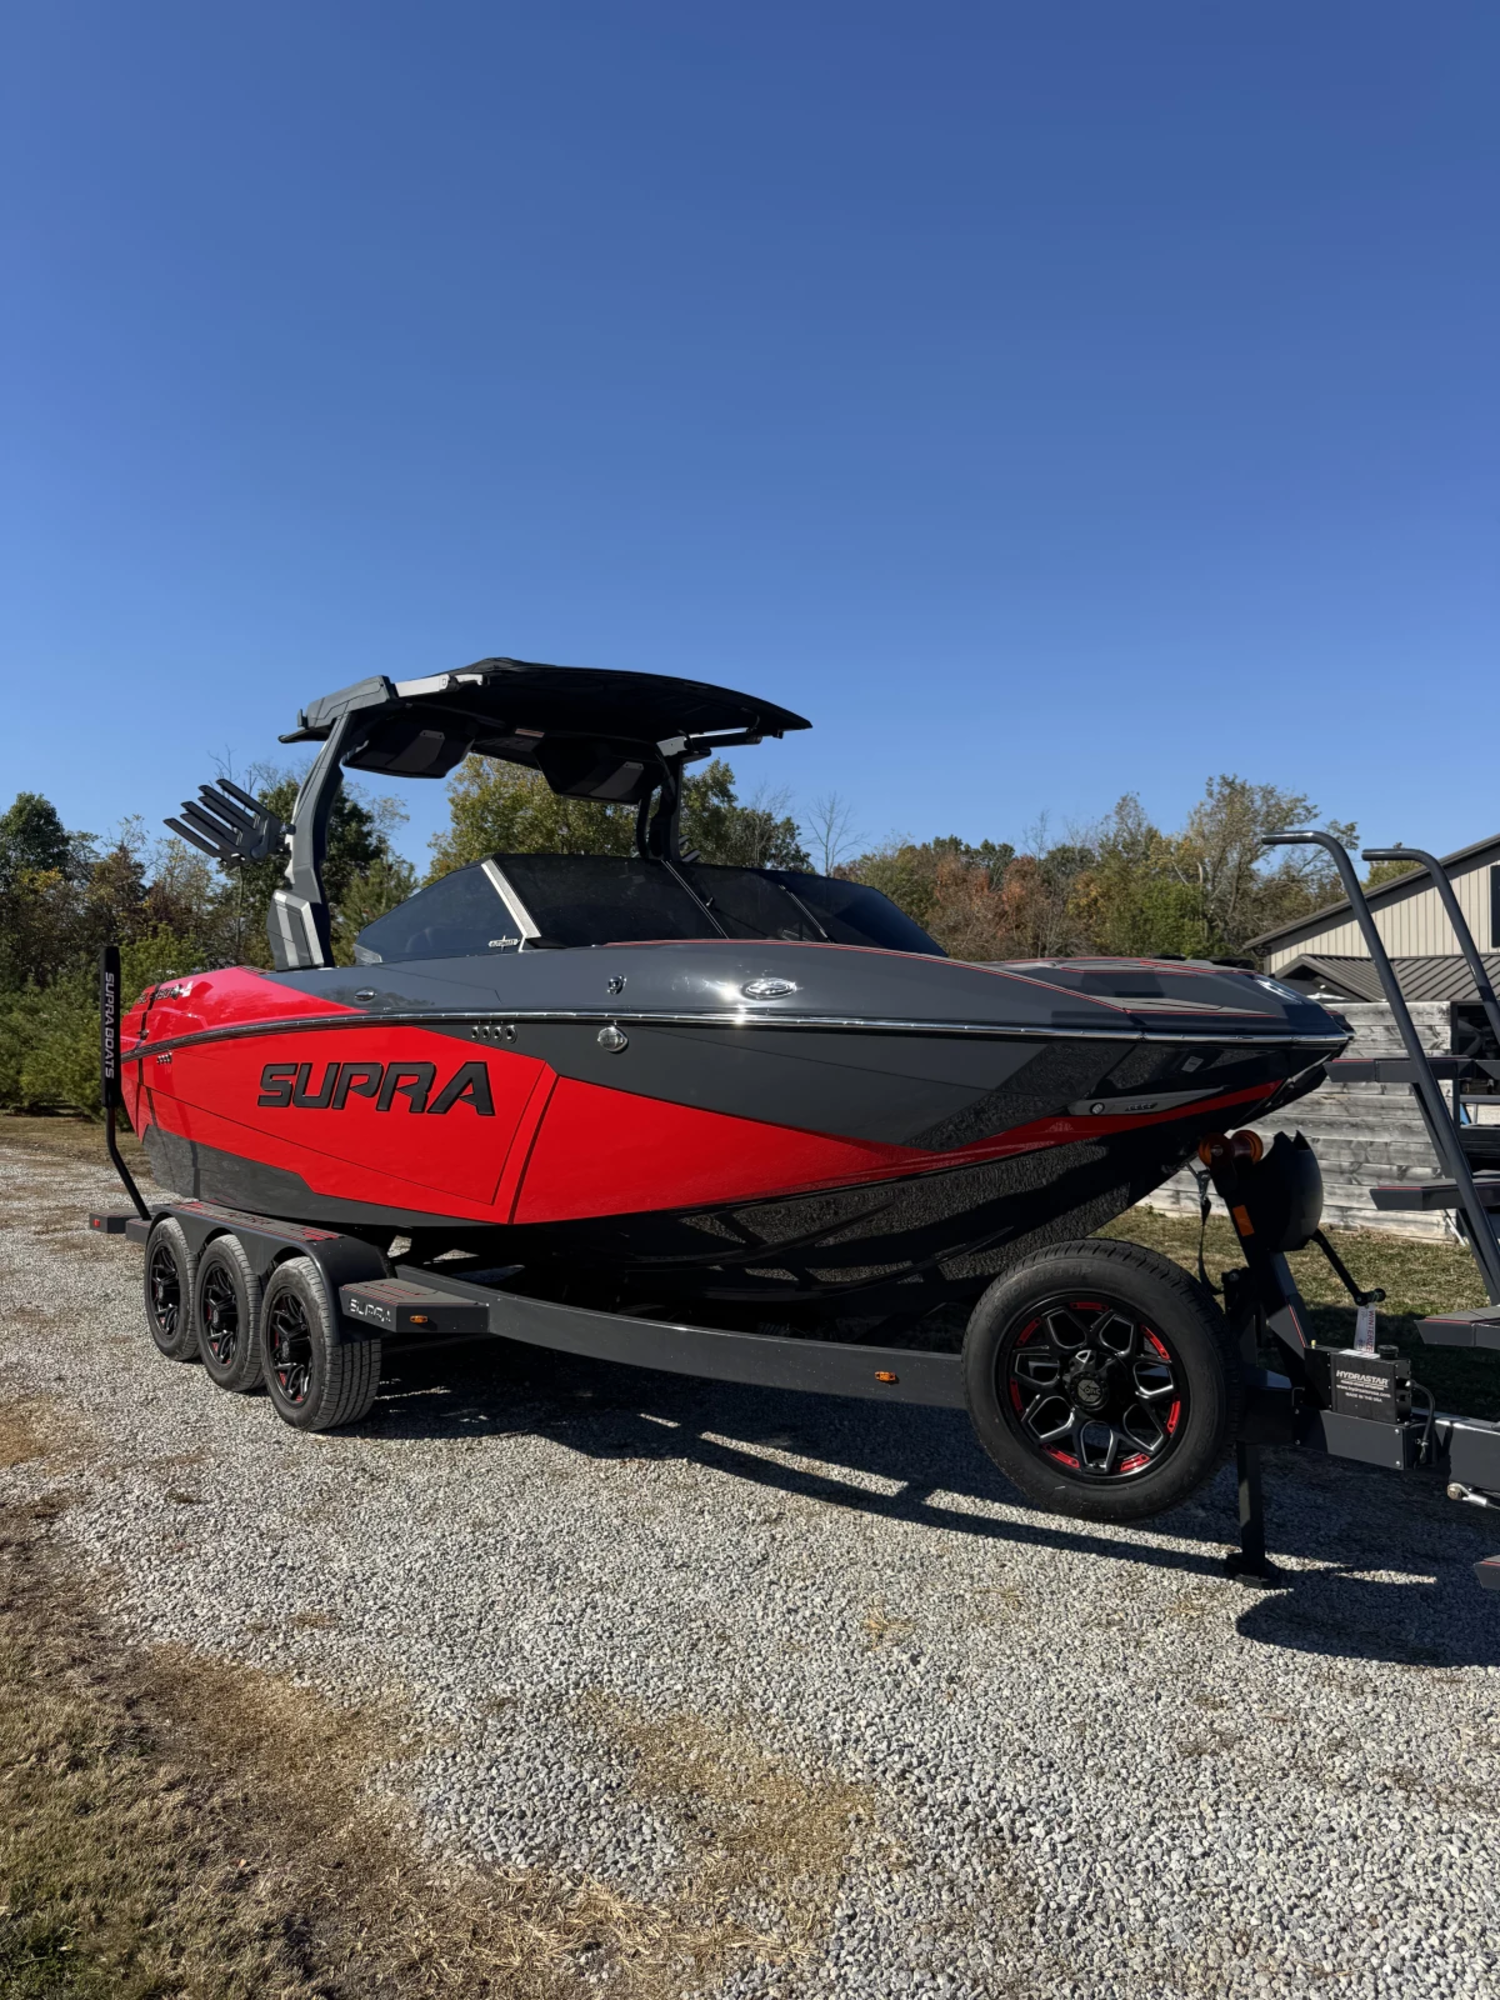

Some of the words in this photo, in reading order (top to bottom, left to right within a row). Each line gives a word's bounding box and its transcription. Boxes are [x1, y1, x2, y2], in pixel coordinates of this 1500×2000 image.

[105, 972, 115, 1025] SUPRA
[105, 1027, 115, 1079] BOATS
[257, 1061, 496, 1116] SUPRA
[350, 1298, 391, 1322] SUPRA
[1336, 1370, 1390, 1386] HYDRASTAR
